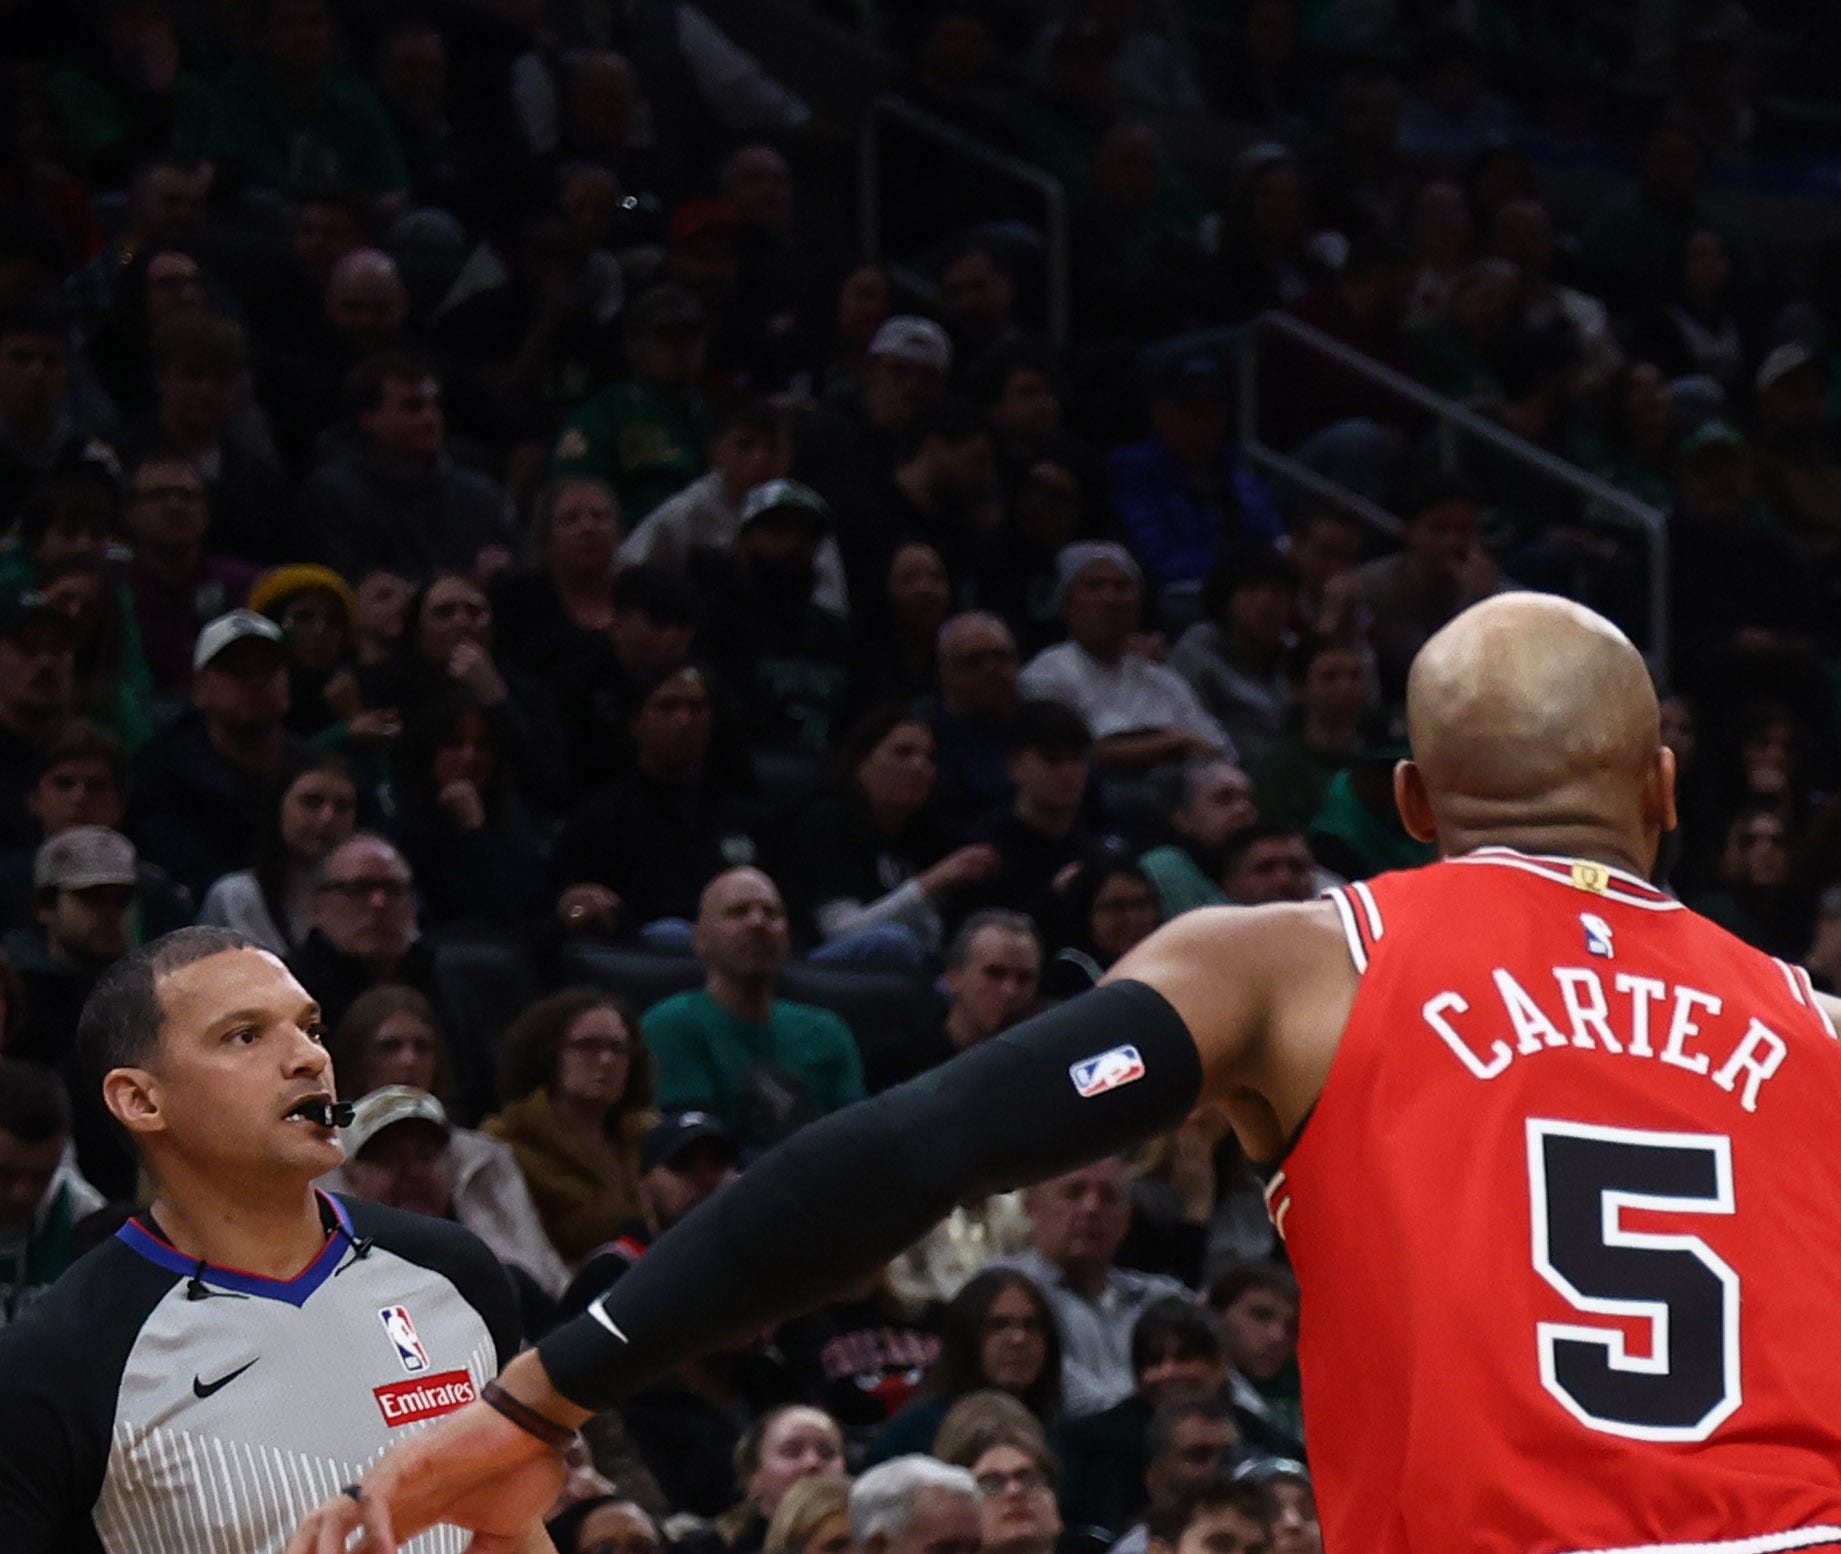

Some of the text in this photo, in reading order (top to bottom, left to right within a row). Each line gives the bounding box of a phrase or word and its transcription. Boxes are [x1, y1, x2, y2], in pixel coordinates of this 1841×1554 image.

[1422, 966, 1788, 1113] CARTER
[1525, 1117, 1742, 1443] 5
[378, 1381, 475, 1419] Emirates
